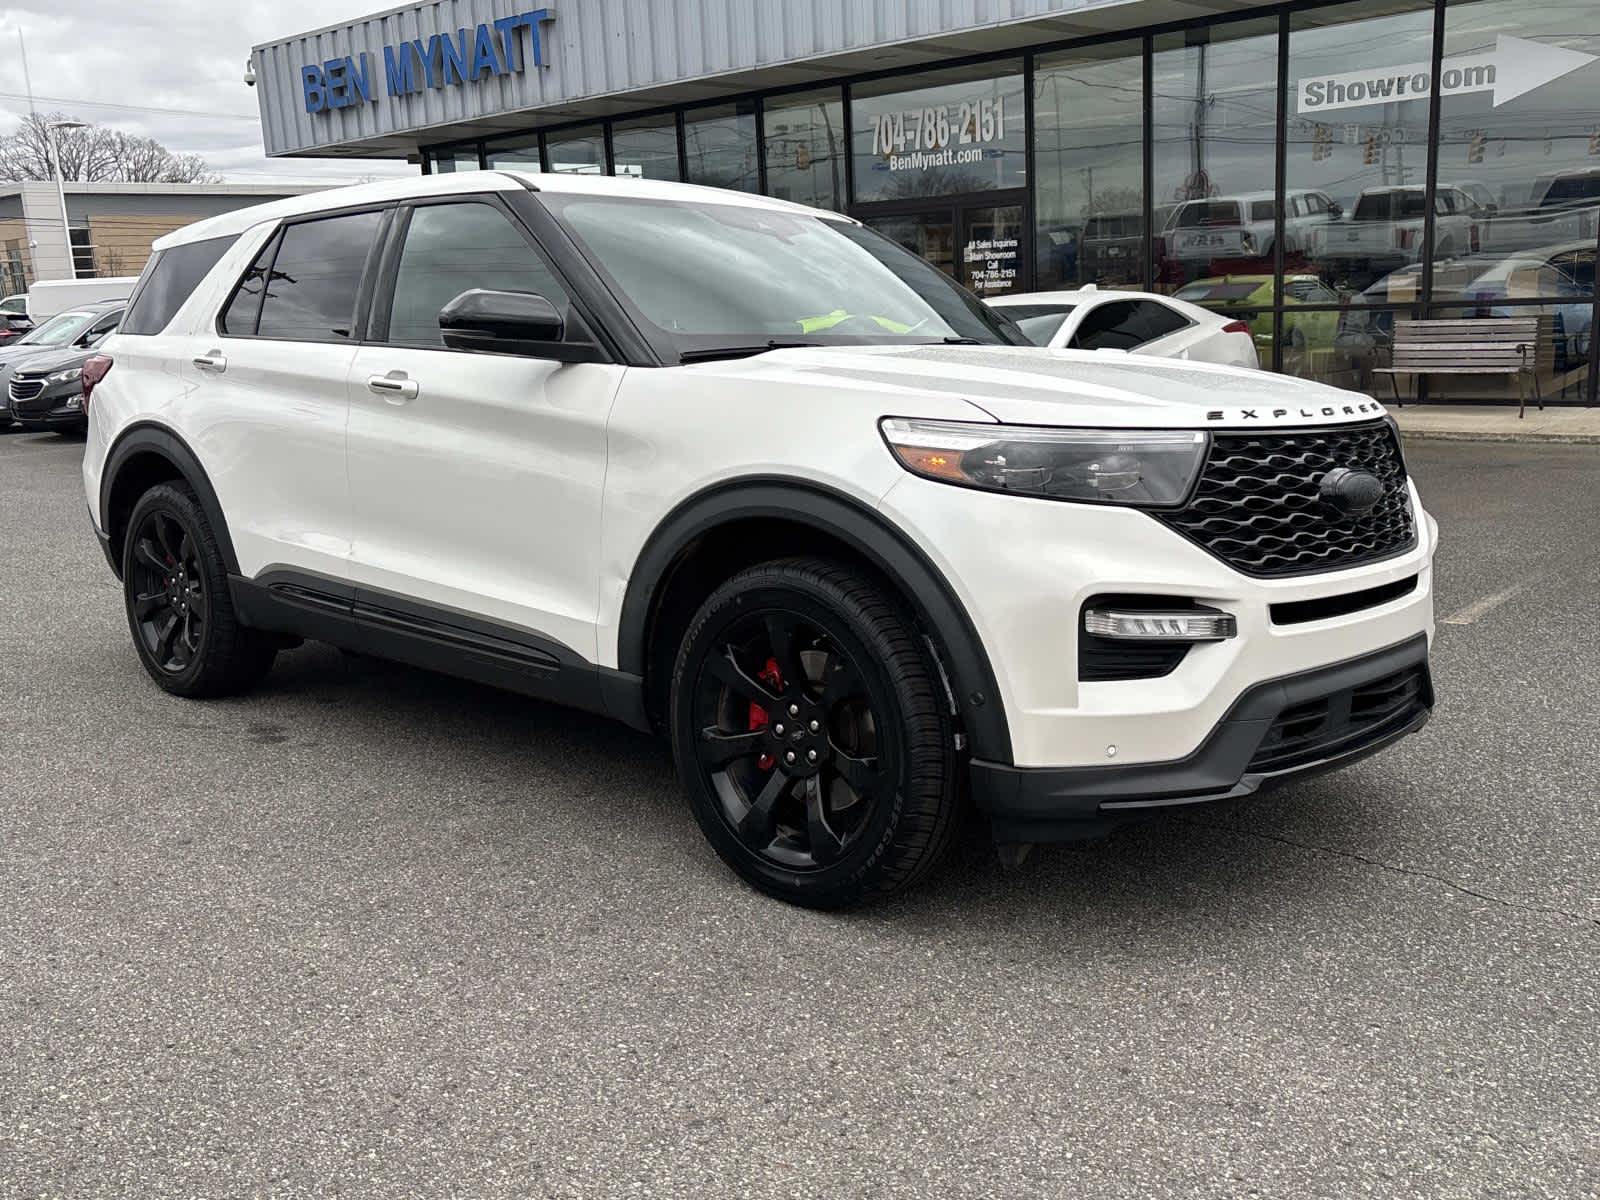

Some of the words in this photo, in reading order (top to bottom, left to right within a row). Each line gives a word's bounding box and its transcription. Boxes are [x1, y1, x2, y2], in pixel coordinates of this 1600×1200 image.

[301, 52, 371, 114] BEN
[383, 8, 549, 97] MYNATT
[1304, 64, 1496, 107] Showroom
[869, 96, 1005, 155] 704-786-2151
[890, 147, 983, 171] BenMynatt.com
[976, 240, 992, 249] Sales
[985, 251, 1017, 260] Showroom
[987, 260, 998, 270] Call
[971, 268, 1016, 280] 704-786-2151
[974, 280, 984, 289] For
[984, 280, 1012, 288] Assistance
[1206, 402, 1380, 420] EXPLORER
